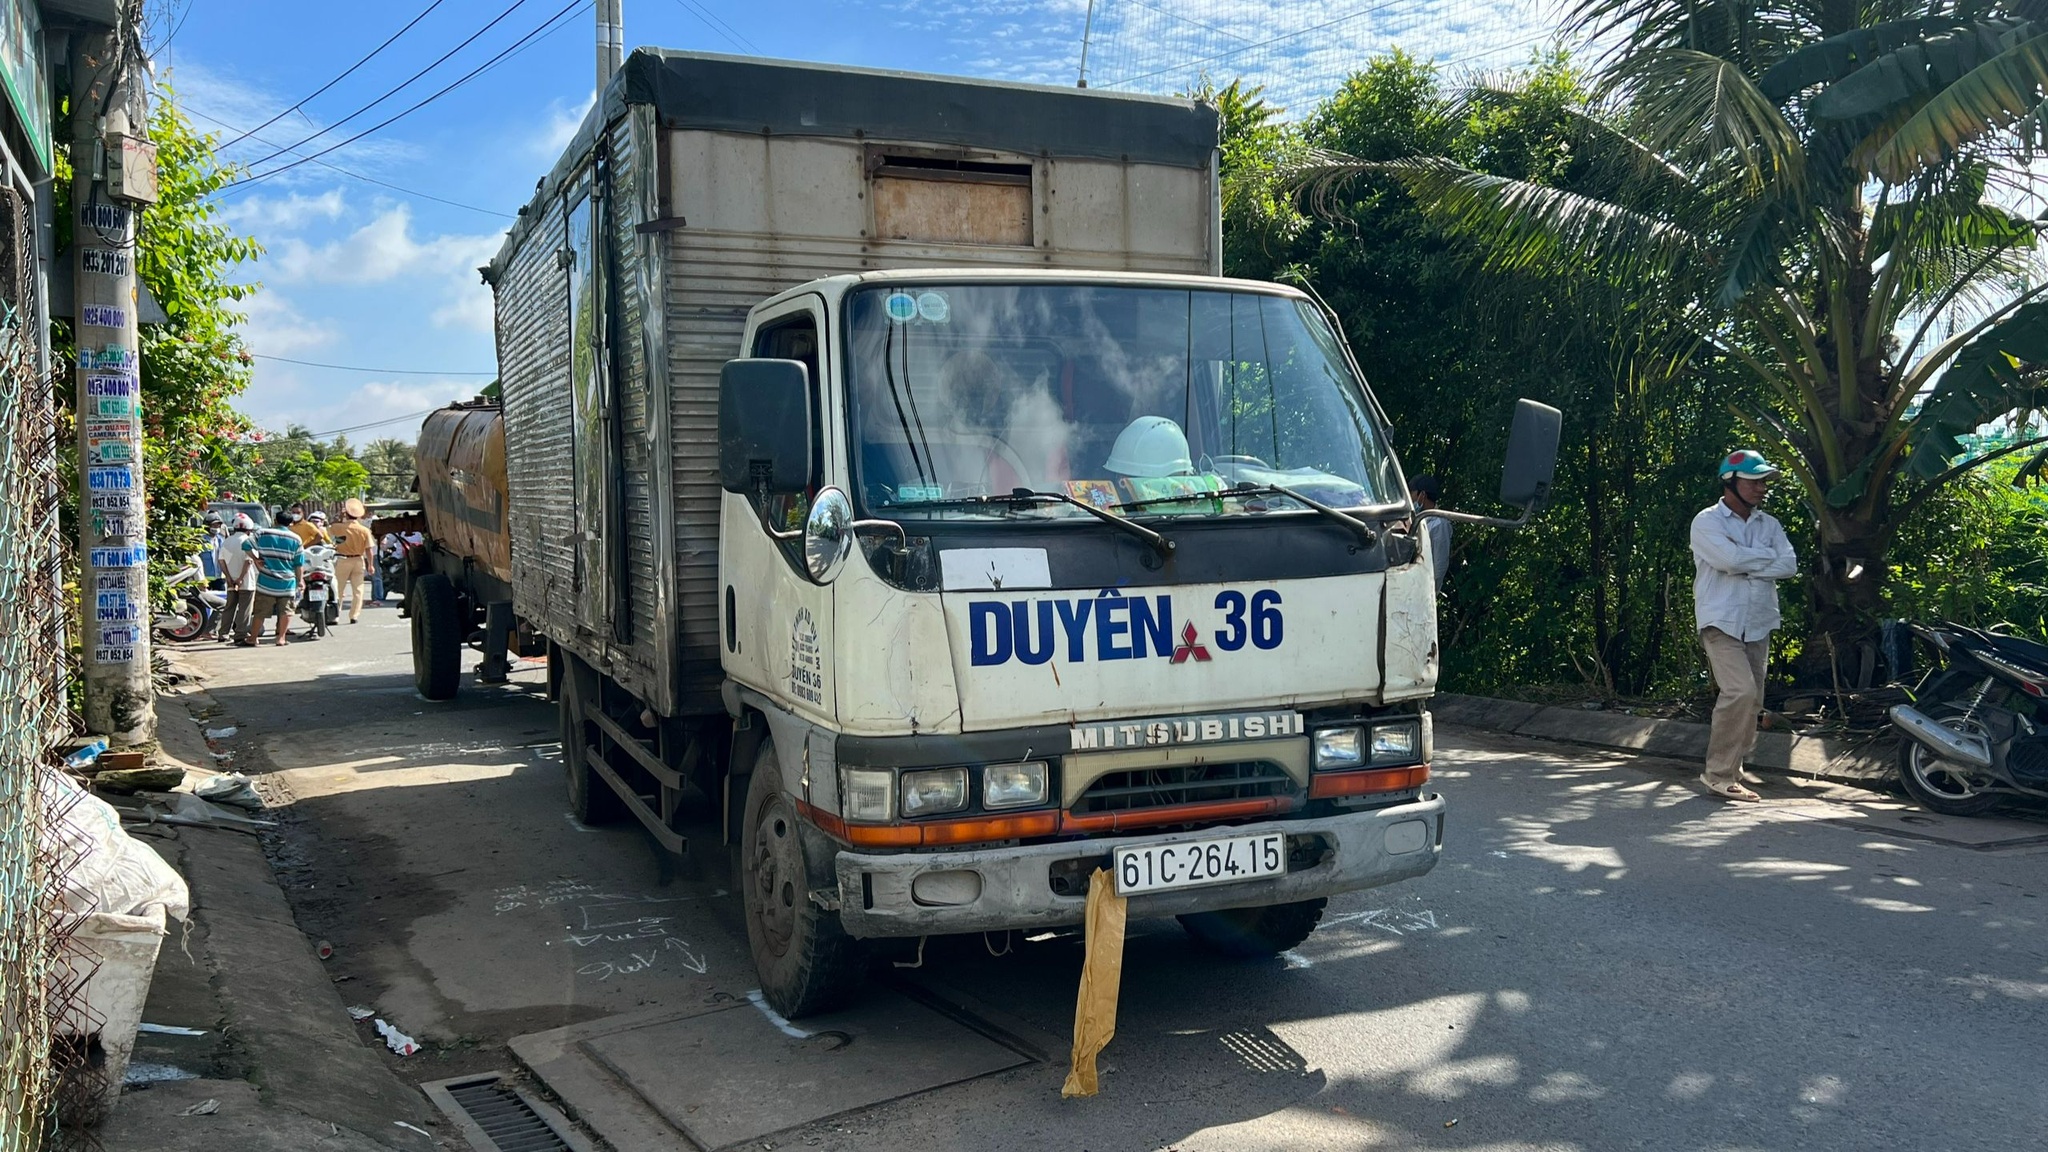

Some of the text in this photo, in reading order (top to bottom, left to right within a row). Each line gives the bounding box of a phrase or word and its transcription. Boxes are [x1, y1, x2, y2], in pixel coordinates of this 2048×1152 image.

[104, 379, 117, 396] 400
[92, 496, 130, 508] 0937 052 054
[1214, 589, 1284, 651] 36
[96, 648, 133, 660] 0937 052 054
[813, 673, 821, 689] 36
[1070, 713, 1304, 750] MITSUBISHI
[1122, 837, 1279, 888] 61C-264.15
